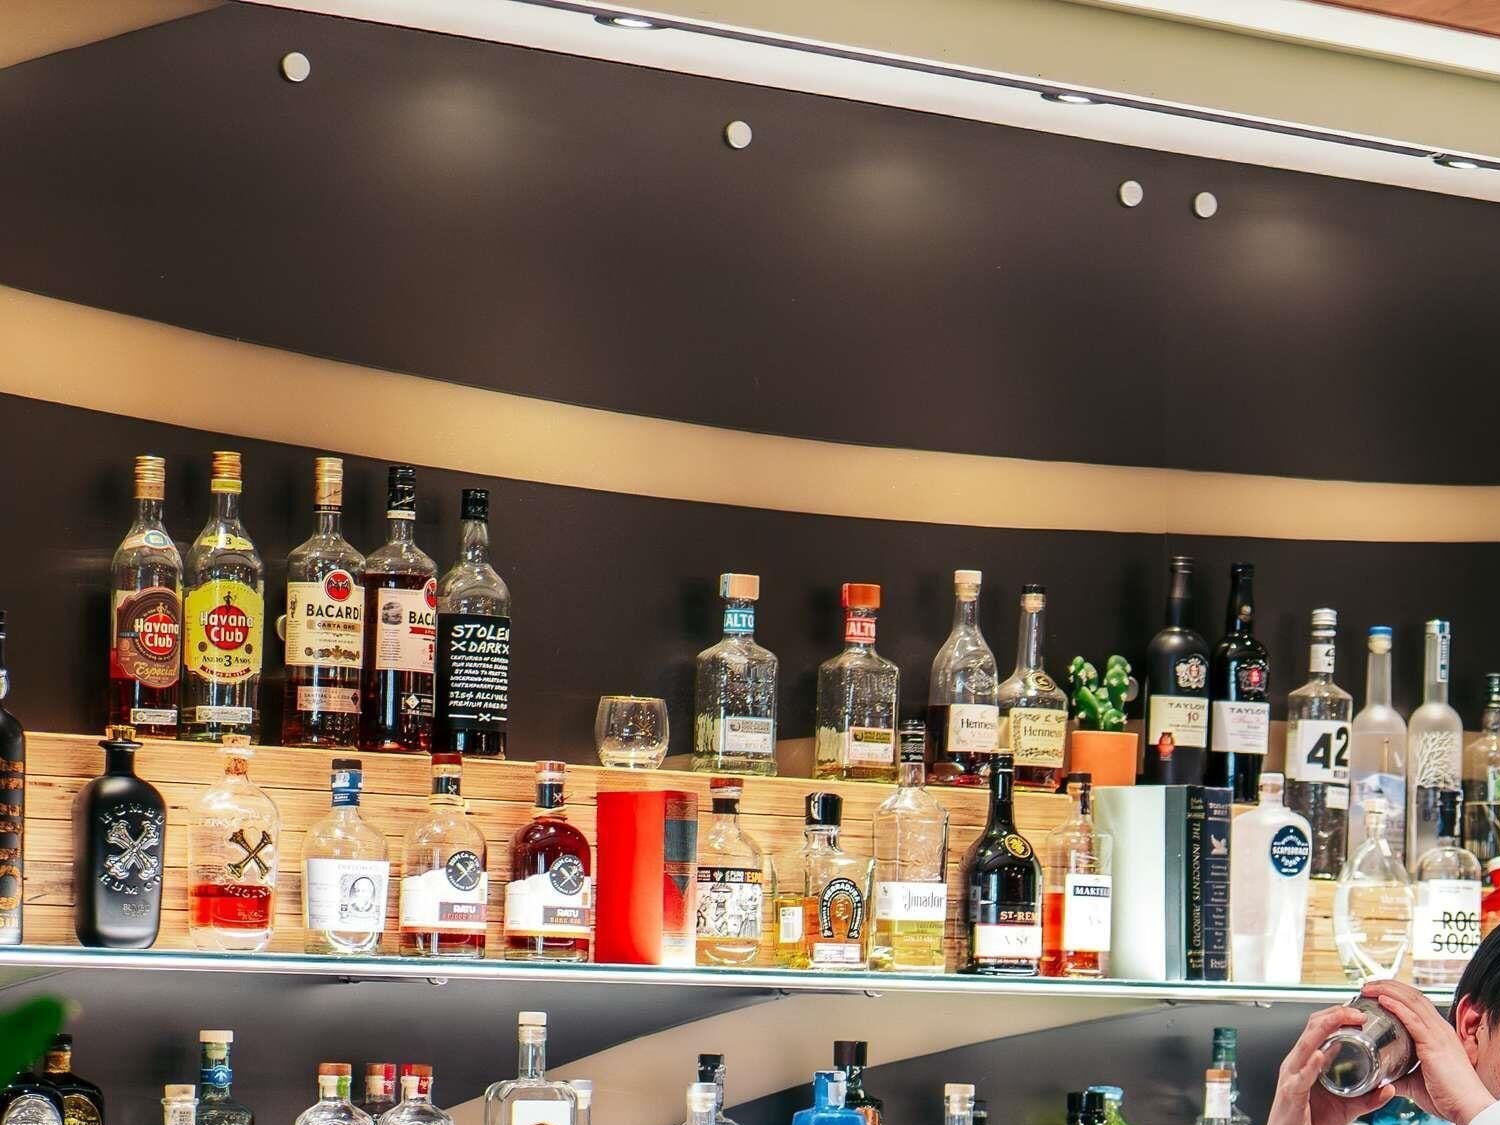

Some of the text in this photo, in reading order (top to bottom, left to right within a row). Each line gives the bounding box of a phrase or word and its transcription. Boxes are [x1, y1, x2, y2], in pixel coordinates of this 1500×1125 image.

[200, 612, 254, 628] Havana
[306, 603, 362, 621] BACARDÍ
[134, 618, 180, 634] Havana
[451, 624, 510, 642] STOLEN
[144, 633, 173, 648] Club
[210, 628, 244, 642] Club
[224, 655, 232, 667] 3
[1306, 726, 1349, 769] 42
[1191, 843, 1201, 901] INNOCENTS
[453, 904, 476, 914] RATU
[556, 908, 580, 918] RATU
[1191, 903, 1201, 947] ABROAD
